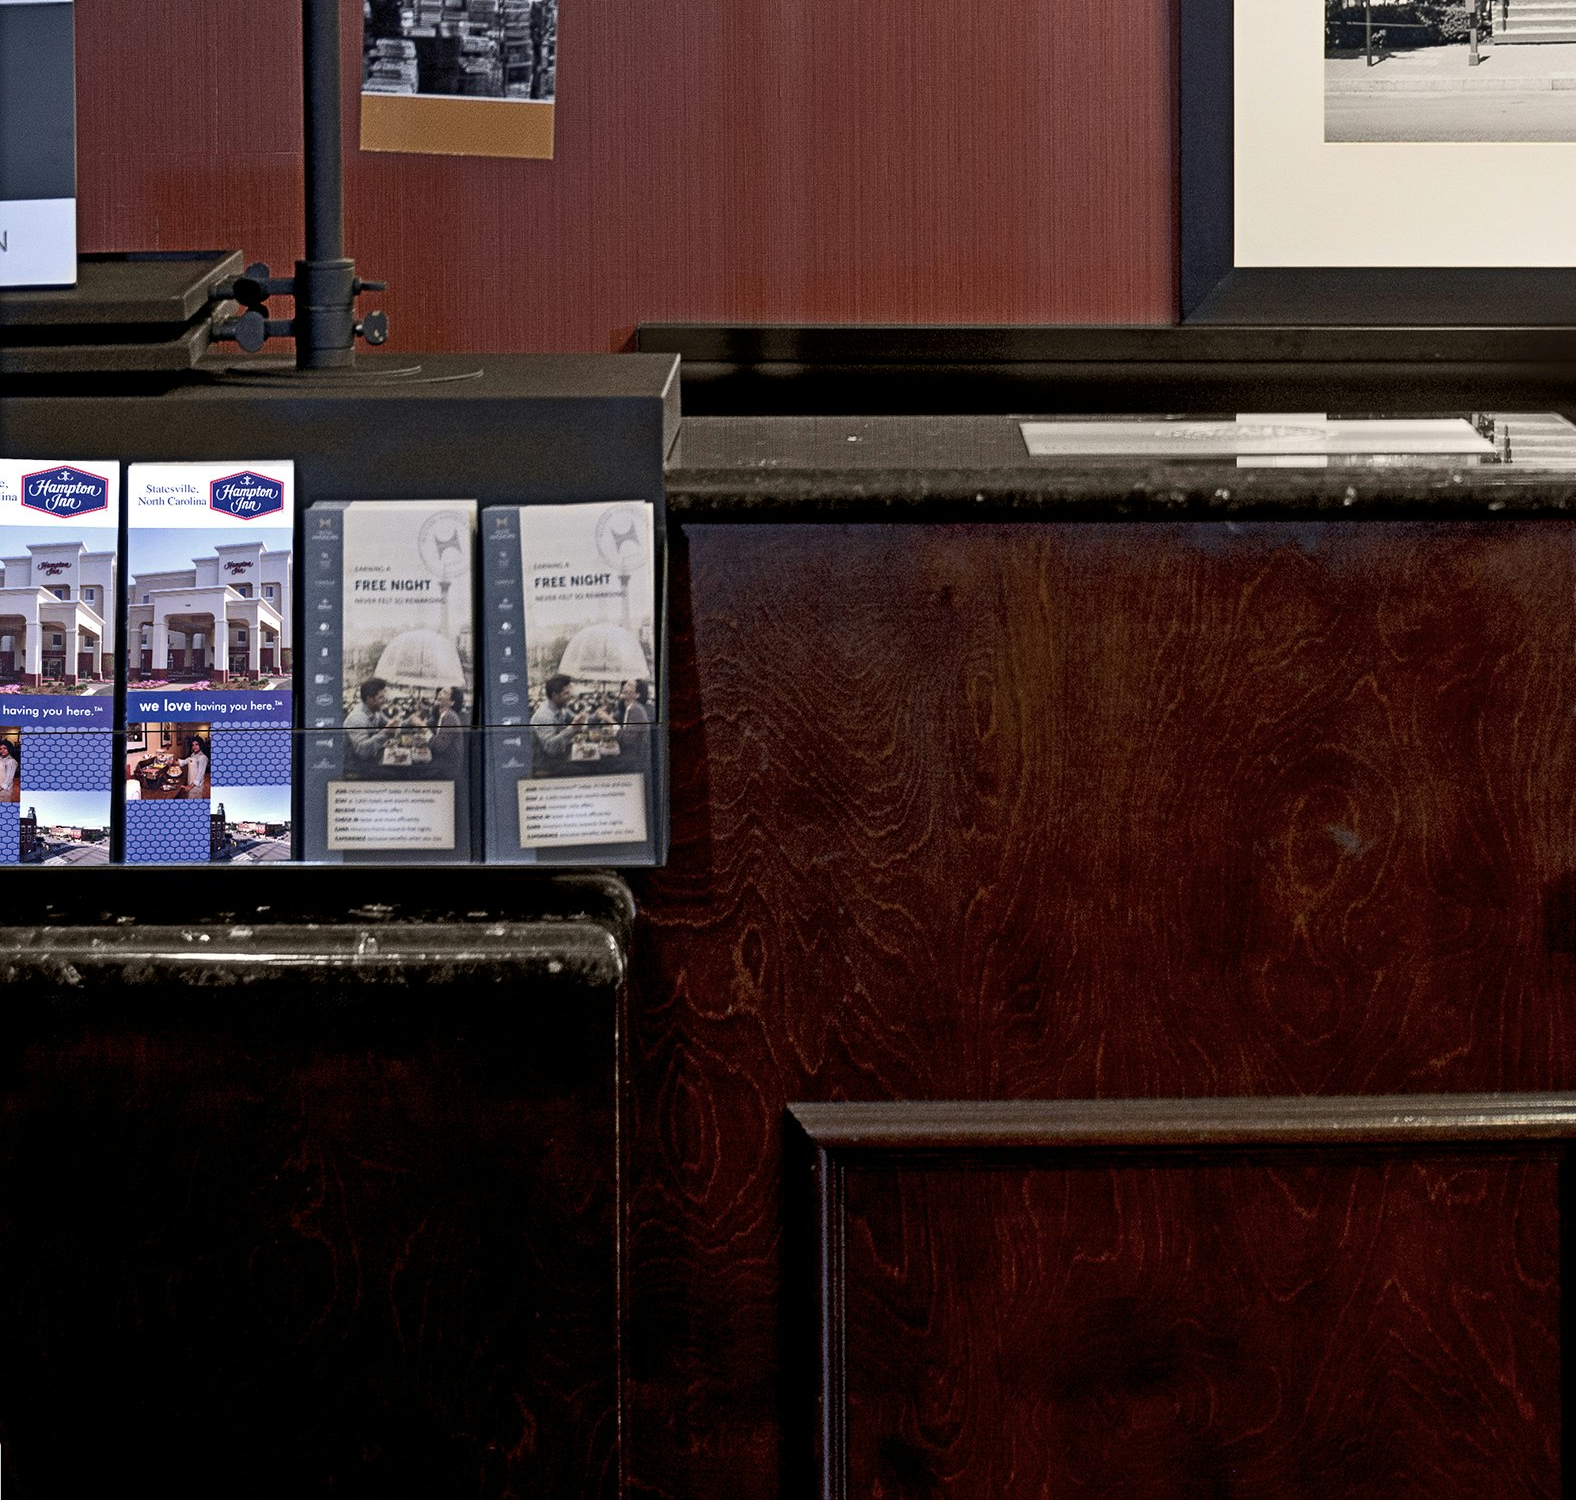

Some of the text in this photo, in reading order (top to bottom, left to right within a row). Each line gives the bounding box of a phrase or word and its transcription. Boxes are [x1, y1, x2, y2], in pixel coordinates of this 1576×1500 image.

[28, 479, 102, 497] Hampton
[215, 484, 279, 501] Hampton
[45, 493, 81, 511] Inn
[138, 496, 207, 506] North Carolina
[230, 497, 262, 513] Inn
[354, 579, 432, 591] FREE NIGHT
[534, 573, 612, 588] FREE NIGHT
[2, 704, 40, 718] having
[42, 708, 63, 718] you
[139, 702, 160, 712] we
[164, 698, 192, 712] love
[194, 700, 228, 715] having
[229, 703, 249, 714] you
